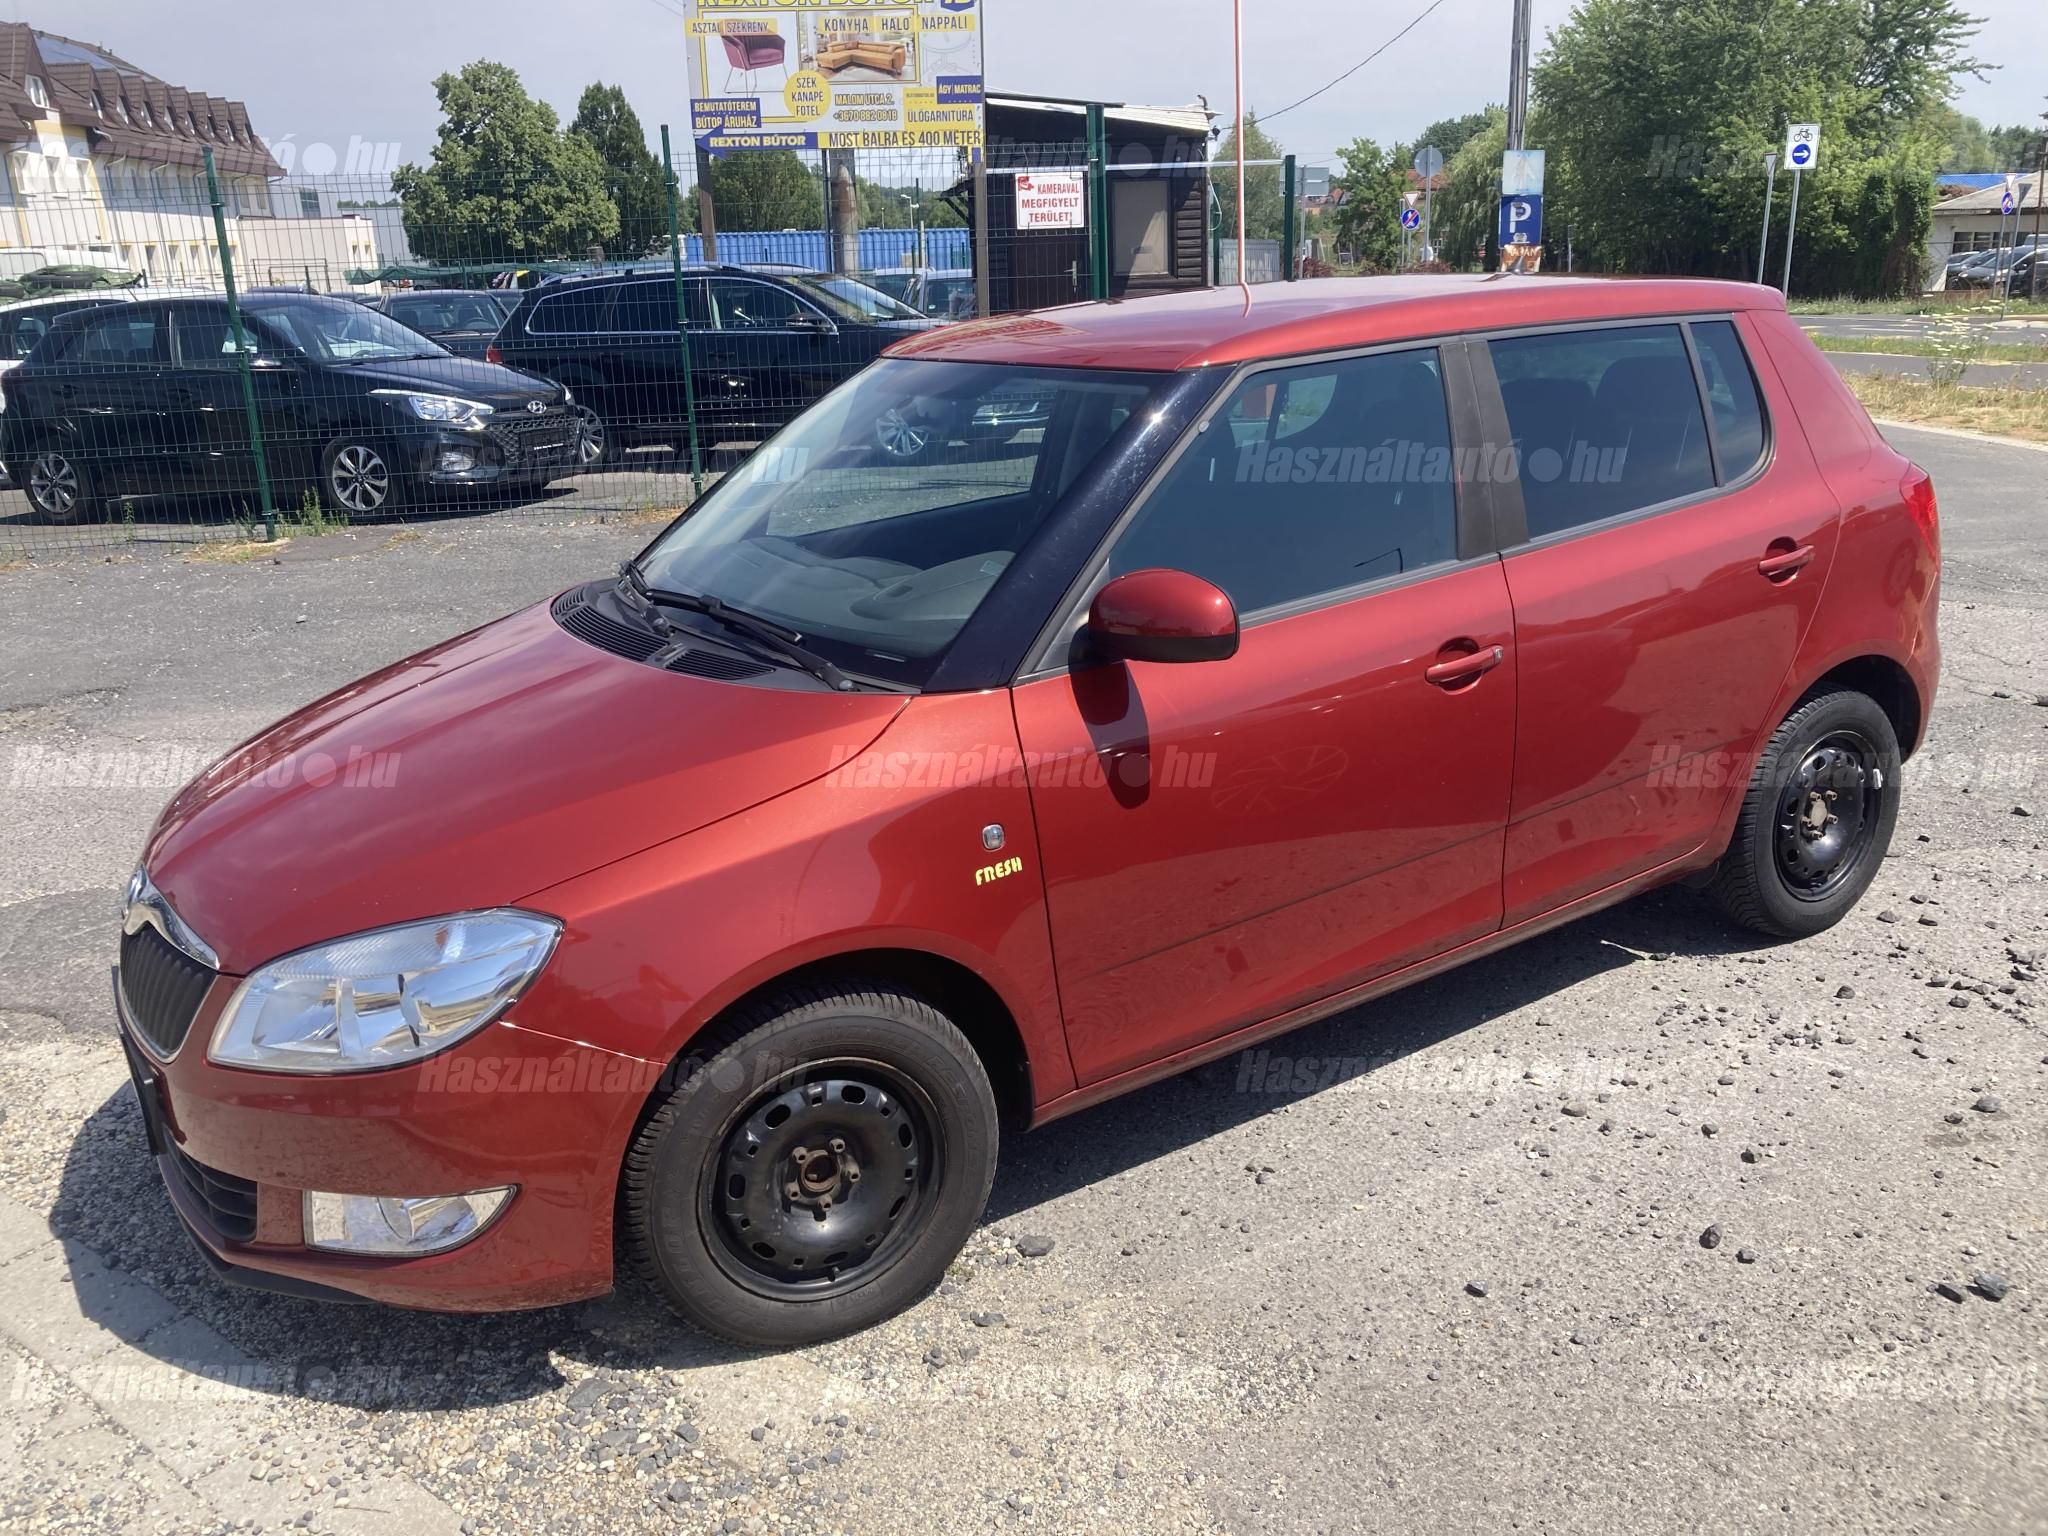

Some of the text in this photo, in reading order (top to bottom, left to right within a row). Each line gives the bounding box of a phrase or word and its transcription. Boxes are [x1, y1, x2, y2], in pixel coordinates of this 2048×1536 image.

[824, 18, 869, 32] KONYHA
[921, 15, 967, 30] NAPPALI
[954, 84, 981, 94] MATRAC
[694, 100, 757, 112] BEMUTATÓTEREM
[834, 94, 864, 105] MALOM
[796, 105, 821, 116] FOTEL
[724, 113, 758, 128] ÁRUHÁZ
[710, 134, 806, 147] REXTON BÚTOR
[829, 132, 860, 147] MOST
[863, 131, 899, 147] BALRA
[919, 131, 940, 145] 400
[1021, 197, 1079, 209] MEGFIGYELT
[1028, 210, 1073, 223] TERÜLET!
[1509, 201, 1532, 233] P
[974, 856, 1023, 886] FRESH
